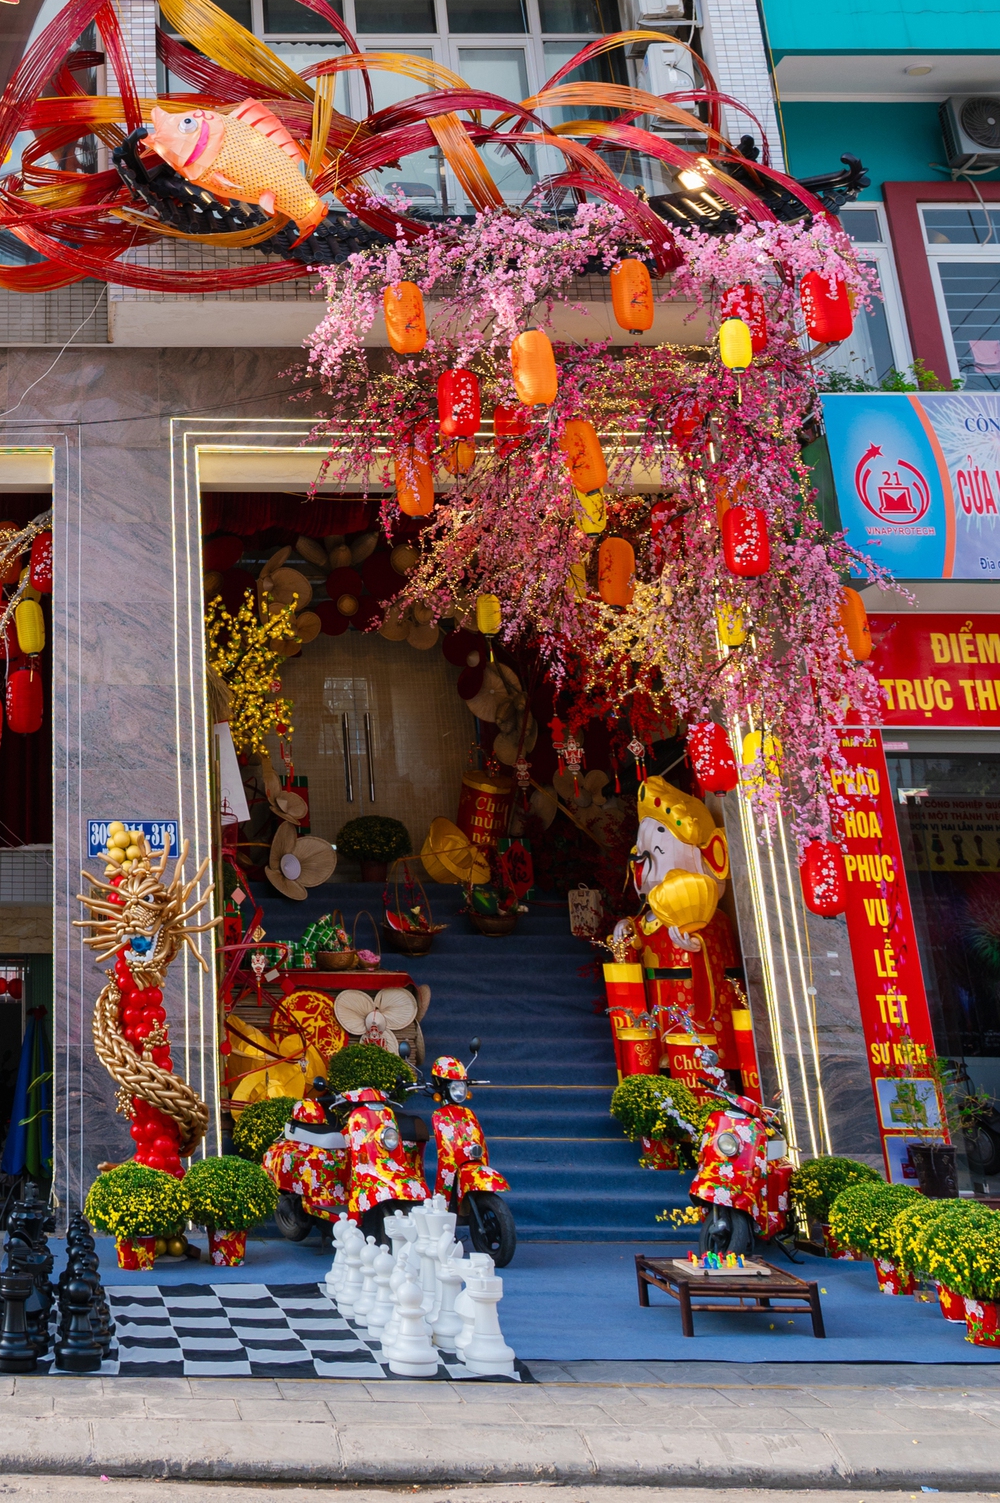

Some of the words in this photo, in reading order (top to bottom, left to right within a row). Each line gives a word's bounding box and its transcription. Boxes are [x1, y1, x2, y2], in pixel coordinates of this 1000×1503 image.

[881, 471, 902, 486] 21
[956, 455, 997, 515] CỬA
[866, 527, 936, 535] VINAPYROTECH
[930, 620, 1000, 664] ĐIỂM
[879, 676, 954, 718] TRỰC
[843, 810, 883, 838] HOA
[843, 854, 895, 888] PHỤC
[863, 898, 890, 933] VỤ
[874, 938, 898, 978] LỄ
[875, 985, 909, 1024] TẾT
